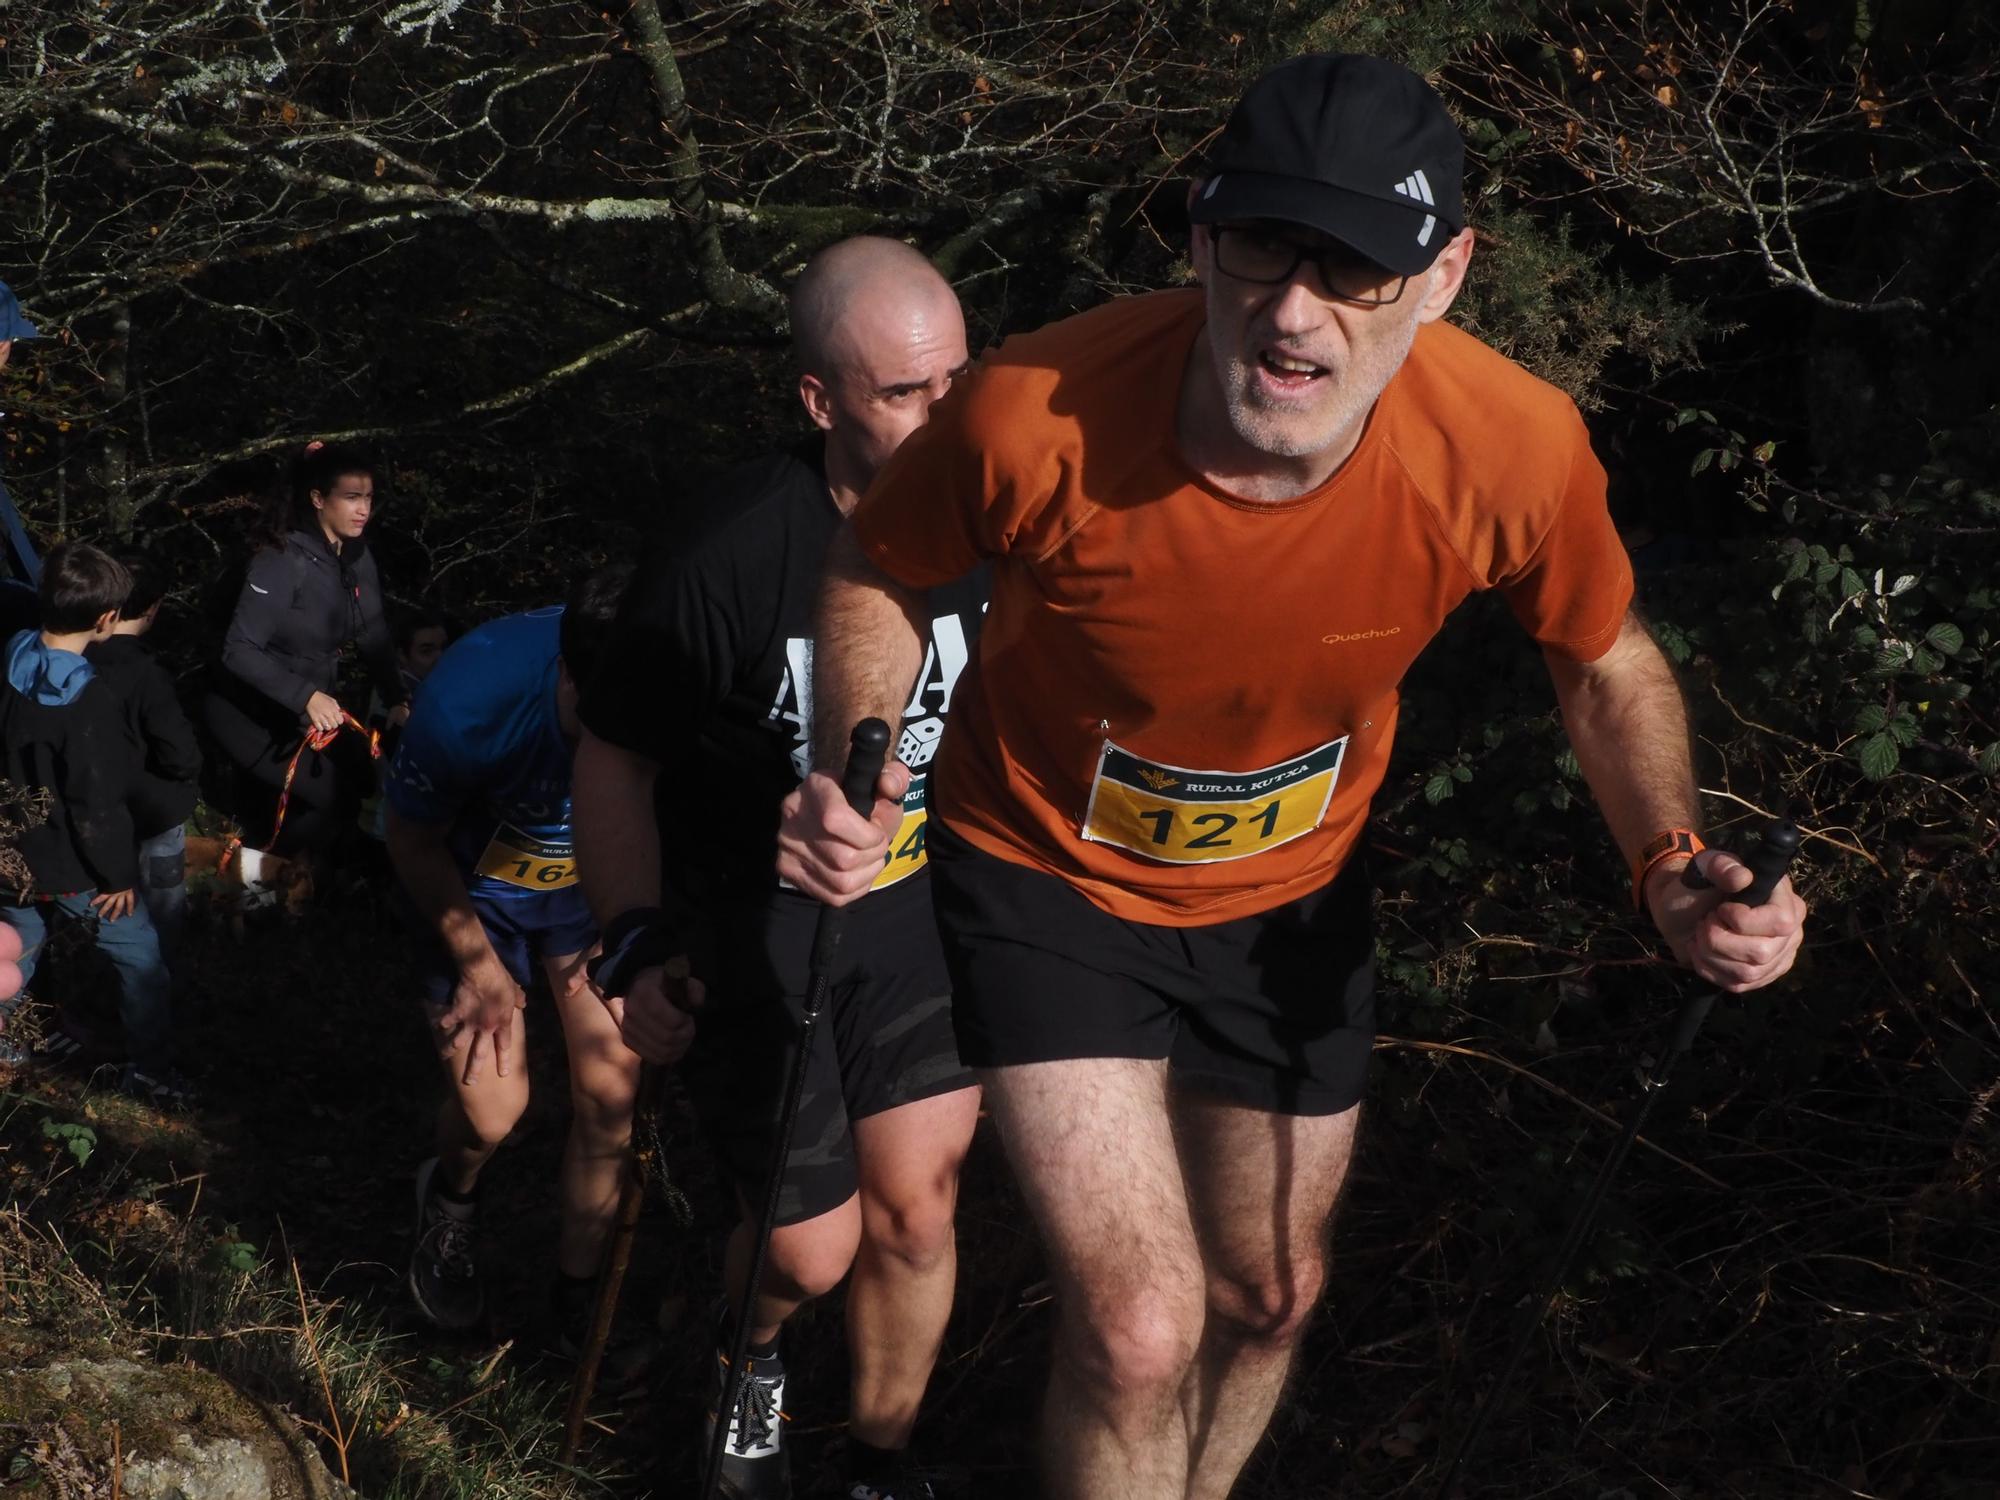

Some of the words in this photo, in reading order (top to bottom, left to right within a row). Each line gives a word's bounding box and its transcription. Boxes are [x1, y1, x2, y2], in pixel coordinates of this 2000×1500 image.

[1185, 782, 1246, 793] RURAL
[1250, 764, 1310, 791] KUTXA
[884, 820, 929, 867] 4
[1140, 800, 1281, 849] 121
